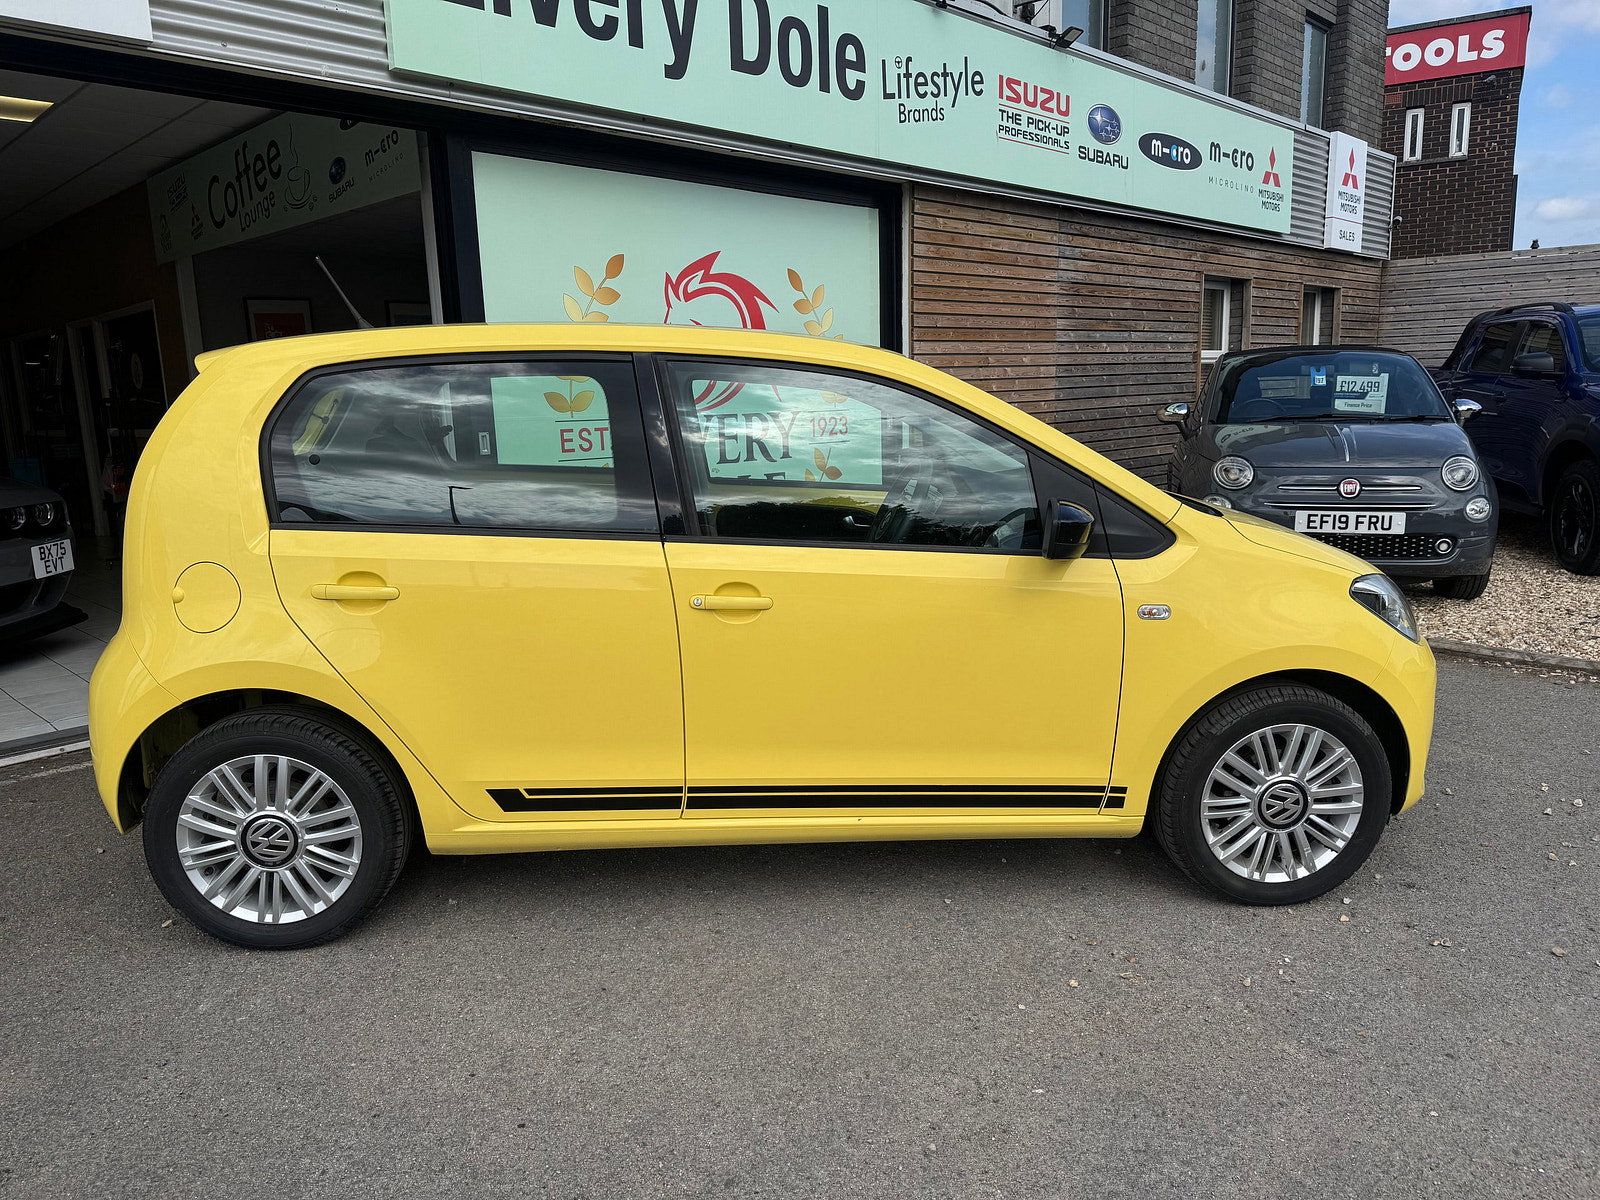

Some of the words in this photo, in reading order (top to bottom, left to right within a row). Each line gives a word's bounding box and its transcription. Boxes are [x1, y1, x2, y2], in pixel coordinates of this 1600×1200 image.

[728, 0, 866, 101] Dole
[881, 56, 984, 108] Lifestyle
[998, 74, 1070, 117] ISUZU
[898, 100, 945, 123] Brands
[999, 109, 1022, 126] THE
[1027, 118, 1070, 138] PICK-UP
[999, 125, 1070, 150] PROFESSIONALS
[1078, 145, 1129, 170] SUBARU
[208, 140, 282, 229] Coffee
[328, 177, 355, 203] SUBARU
[1208, 175, 1254, 194] MICROLINO
[1258, 188, 1285, 202] MITSUBISHI
[1261, 201, 1281, 212] MOTORS
[1338, 190, 1361, 205] MITSUBISHI
[1340, 202, 1358, 215] MOTORS
[239, 191, 276, 232] Lounge
[1338, 229, 1355, 242] SALES
[809, 415, 849, 438] 1923
[559, 427, 609, 454] EST
[1344, 483, 1356, 493] FIAT
[1307, 513, 1349, 530] EF19
[1355, 514, 1393, 531] FRU
[39, 542, 67, 561] BX75
[44, 557, 65, 574] EVT
